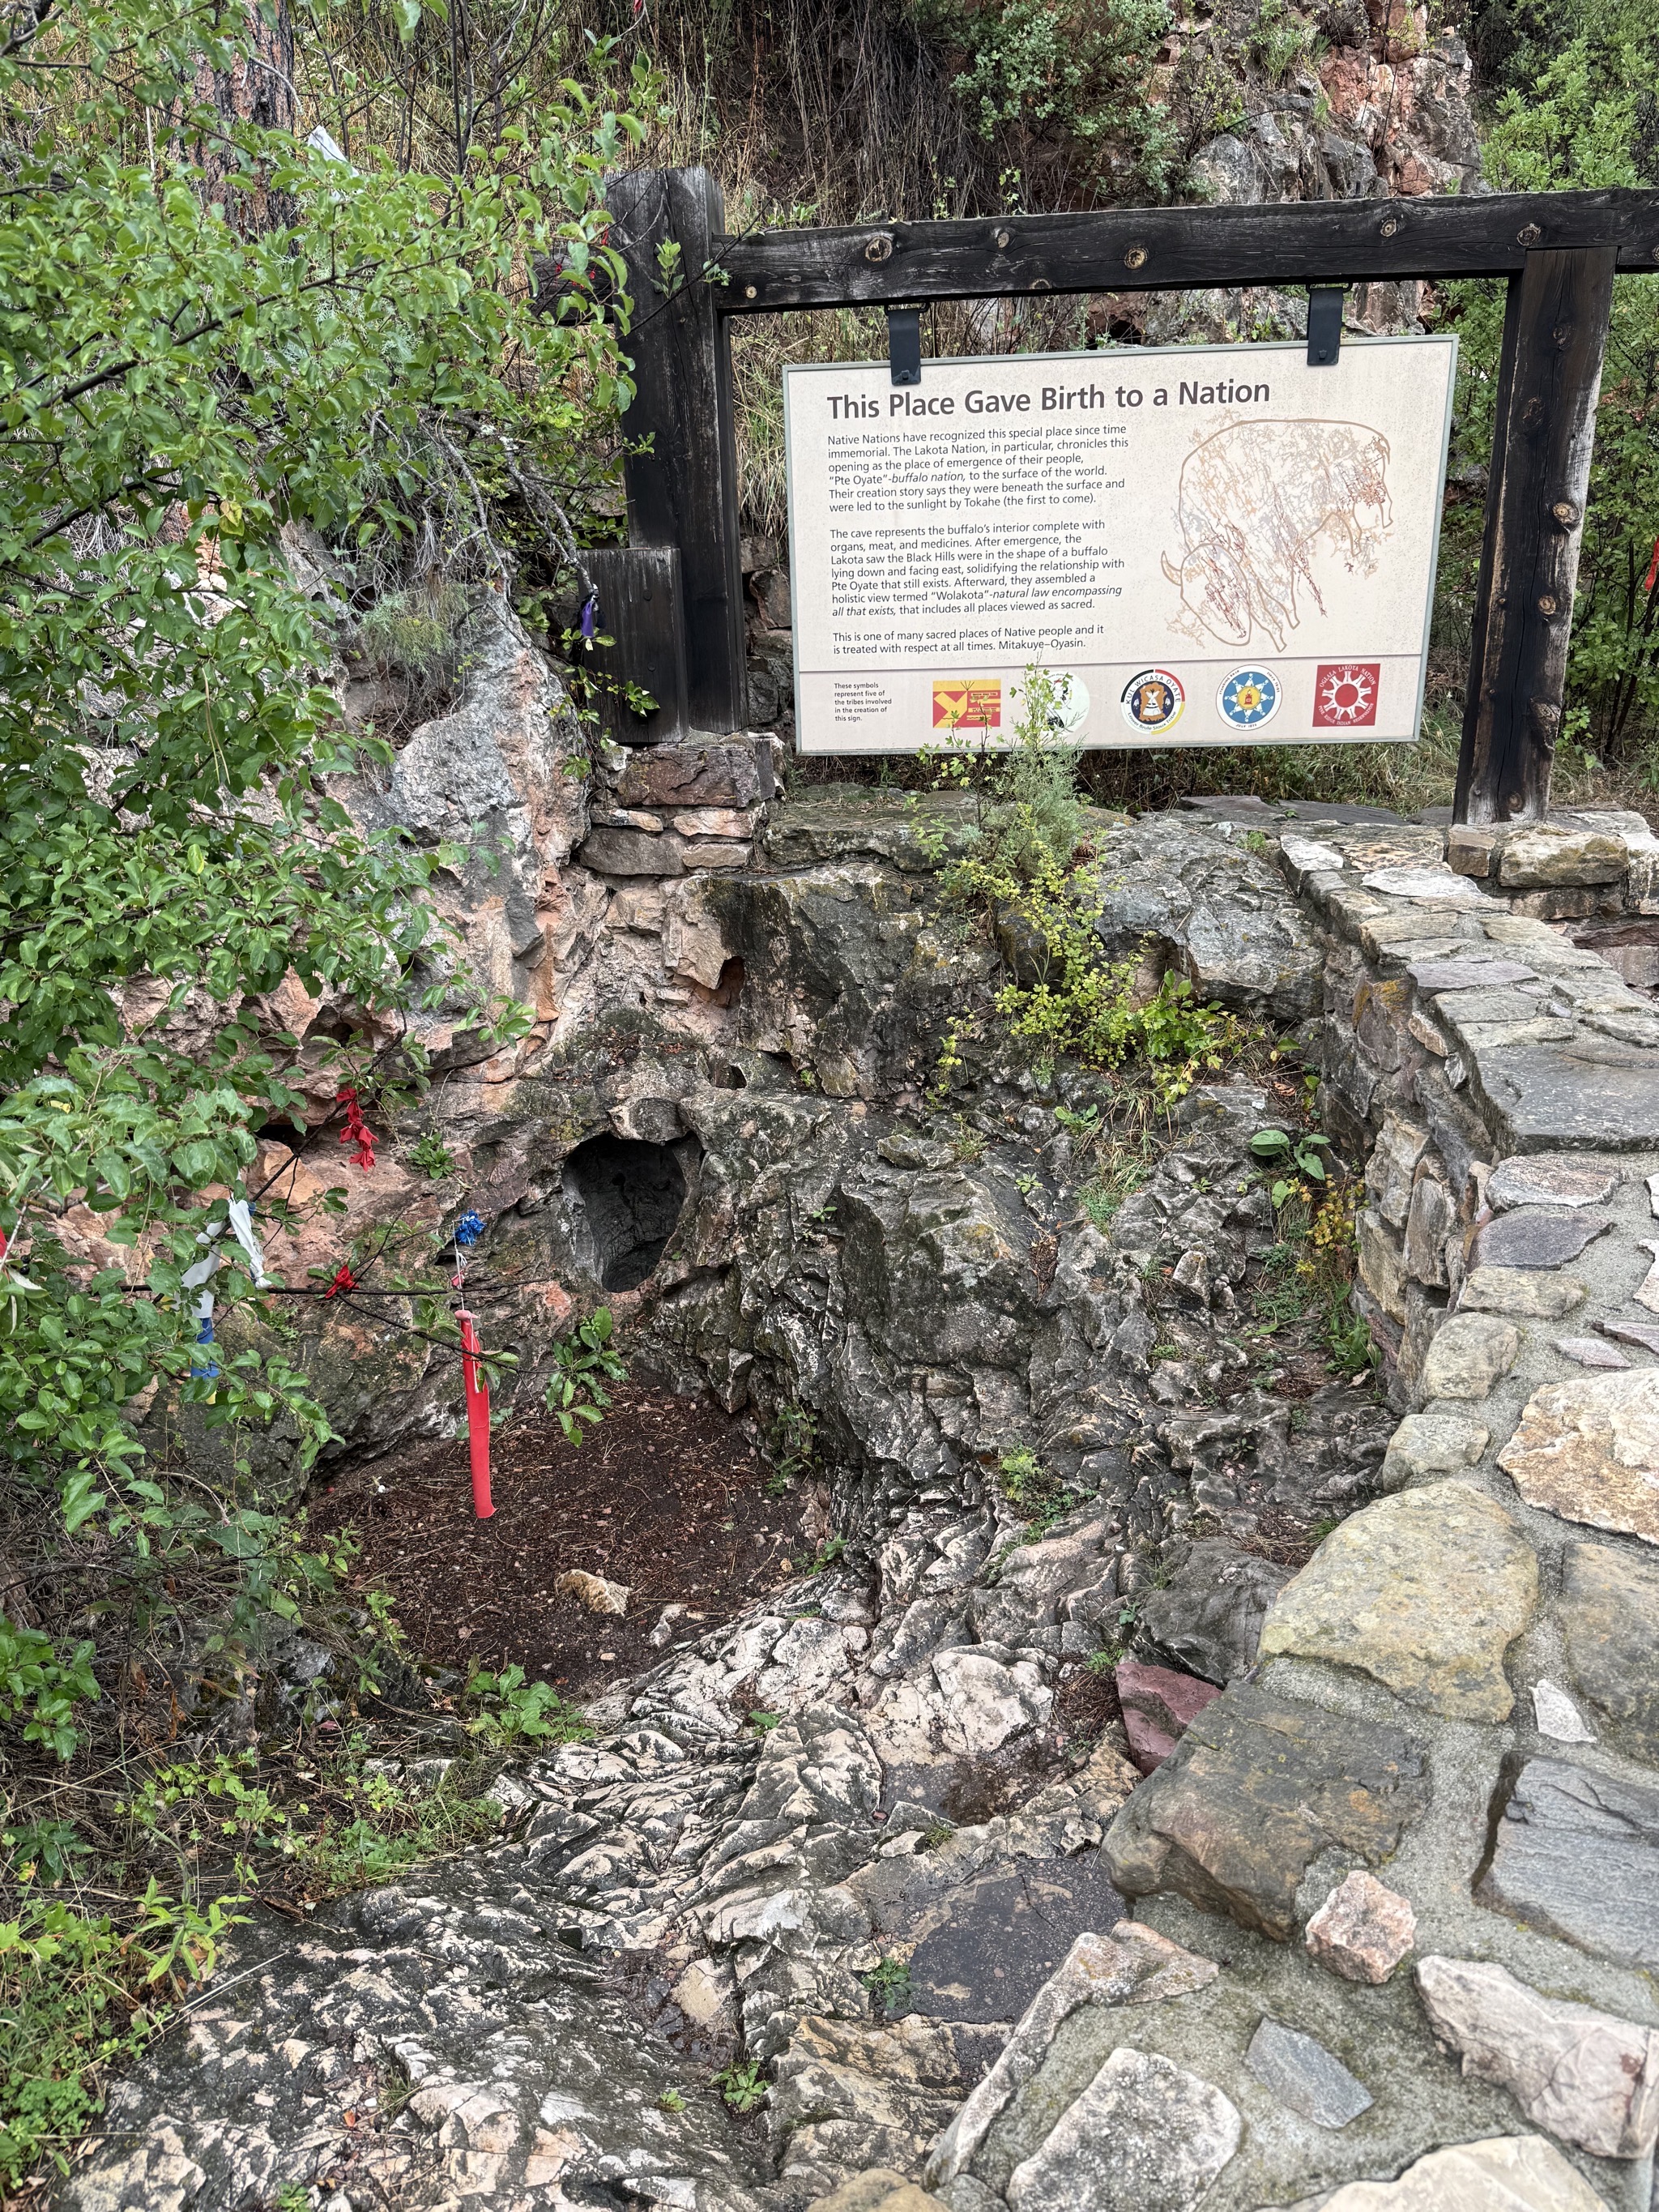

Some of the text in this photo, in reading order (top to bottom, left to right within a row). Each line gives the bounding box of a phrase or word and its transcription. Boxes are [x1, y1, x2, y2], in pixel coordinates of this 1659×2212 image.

[827, 378, 1269, 419] This Place Gave Birth to a Nation
[828, 424, 1126, 445] Native Nations have recognized this special place since time
[828, 437, 1128, 458] immemorial. The Lakota Nation, in particular, chronicles this
[829, 461, 869, 474] opening
[885, 460, 901, 470] the
[905, 459, 930, 471] place
[933, 458, 944, 468] of
[947, 458, 1002, 469] emergence
[1006, 455, 1016, 465] of
[1019, 454, 1043, 465] their
[1046, 453, 1083, 466] people,
[931, 471, 965, 482] nation,
[969, 472, 980, 480] to
[983, 470, 999, 479] the
[1002, 468, 1038, 479] surface
[1041, 467, 1052, 477] of
[1055, 467, 1072, 477] the
[1075, 465, 1107, 476] world.
[857, 501, 871, 511] led
[874, 502, 885, 510] to
[888, 500, 904, 510] the
[907, 499, 947, 511] sunlight
[950, 498, 961, 510] by
[964, 497, 1000, 507] Tokahe
[1004, 496, 1023, 507] (the
[1027, 495, 1046, 504] first
[1049, 496, 1060, 504] to
[1063, 493, 1096, 504] come).
[830, 529, 848, 538] The
[875, 527, 925, 539] represents
[928, 525, 944, 535] the
[993, 522, 1030, 533] interior
[1033, 521, 1079, 533] complete
[1082, 519, 1105, 529] with
[831, 534, 1081, 554] organs, meat, and medicines. After emergence, the
[832, 559, 1124, 580] lying down and facing east, solidifying the relationship with
[832, 582, 847, 591] Pte
[850, 581, 878, 592] Oyate
[881, 580, 901, 589] that
[904, 579, 919, 589] still
[923, 578, 951, 588] exists.
[954, 576, 1007, 587] Afterward,
[1011, 575, 1032, 587] they
[1035, 573, 1086, 584] assembled
[832, 594, 865, 603] holistic
[868, 593, 890, 602] view
[893, 591, 927, 602] termed
[1031, 588, 1050, 597] law
[1052, 585, 1122, 598] encompassing
[832, 607, 844, 616] all
[847, 607, 866, 616] that
[869, 606, 896, 616] exists,
[899, 605, 919, 614] that
[922, 604, 961, 613] includes
[964, 603, 975, 612] all
[978, 603, 1007, 614] places
[1010, 600, 1045, 611] viewed
[1061, 599, 1095, 609] sacred.
[833, 632, 852, 641] This
[854, 632, 861, 641] is
[884, 631, 894, 640] of
[897, 633, 923, 642] many
[926, 629, 956, 639] sacred
[959, 629, 988, 640] places
[991, 628, 1001, 637] of
[1005, 627, 1035, 637] Native
[1039, 626, 1072, 638] people
[1075, 625, 1094, 634] and
[1097, 624, 1104, 633] it
[834, 645, 840, 654] is
[843, 644, 877, 654] treated
[880, 644, 901, 653] with
[904, 644, 938, 654] respect
[941, 643, 950, 651] at
[953, 642, 964, 651] all
[967, 641, 995, 650] times.
[1319, 670, 1336, 687] OGLALA
[1361, 668, 1376, 685] NATION
[1126, 675, 1181, 704] KUL WICASA OYATE
[1128, 712, 1139, 726] Lower
[1166, 712, 1176, 723] Tribe
